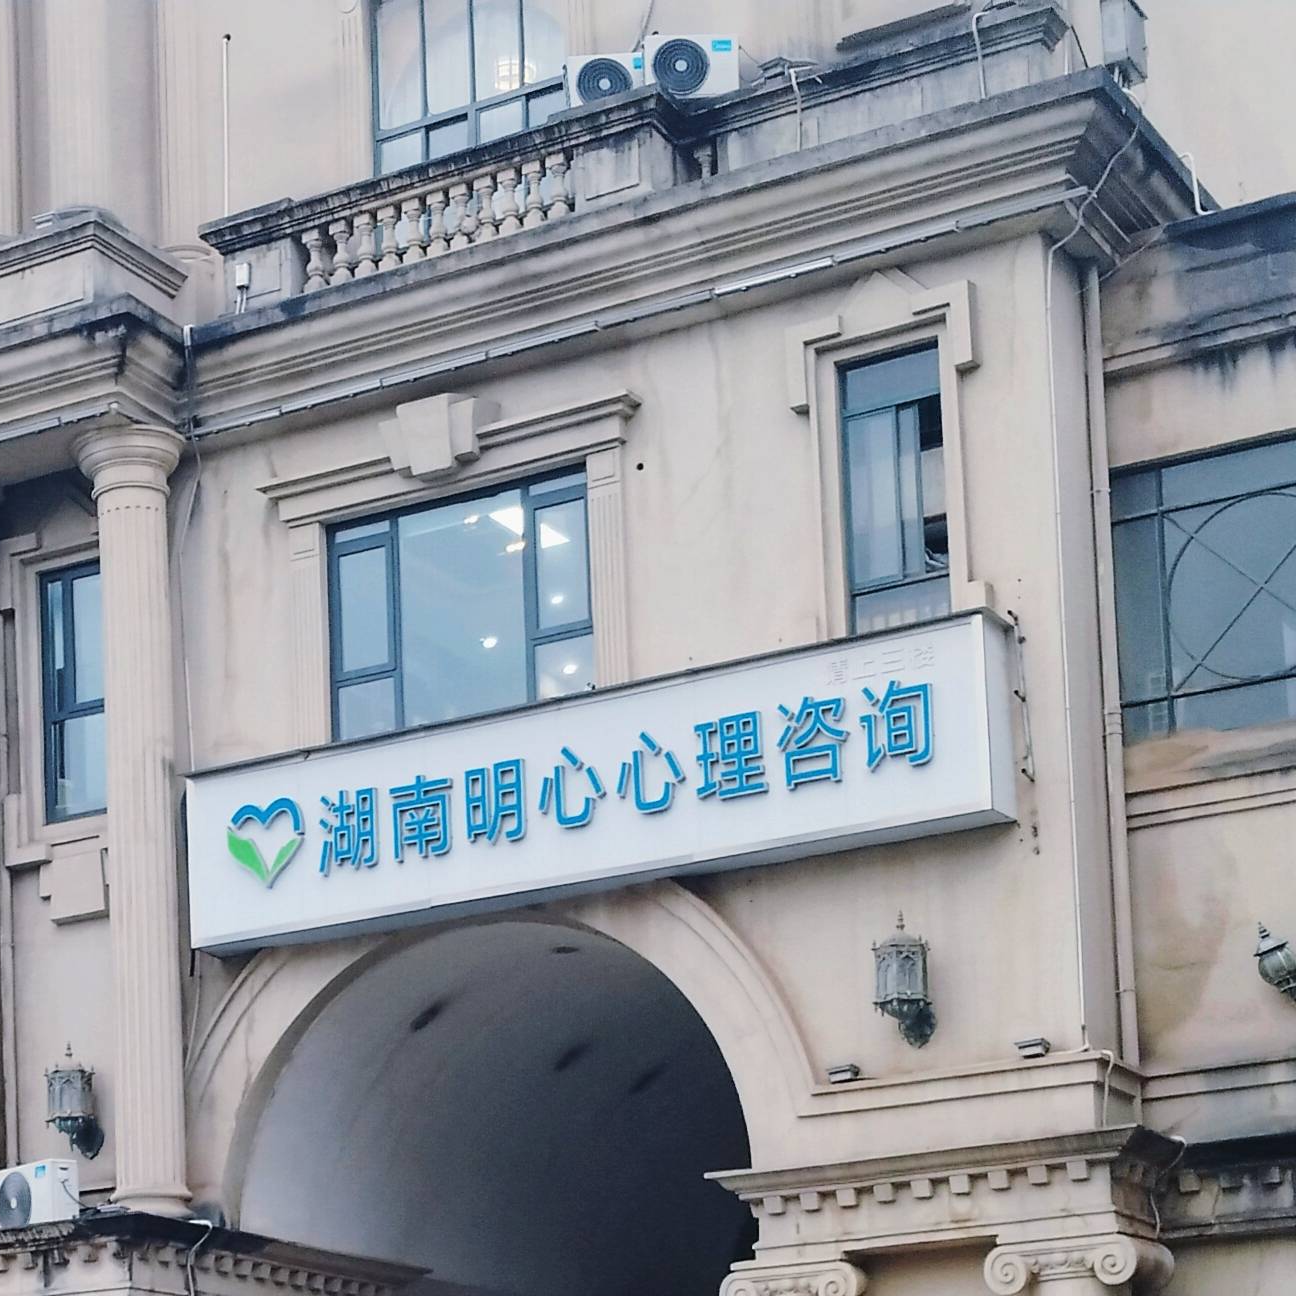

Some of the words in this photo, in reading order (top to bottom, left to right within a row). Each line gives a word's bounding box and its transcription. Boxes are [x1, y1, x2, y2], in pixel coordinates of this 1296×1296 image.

[316, 679, 935, 876] 湖南明心心理咨询
